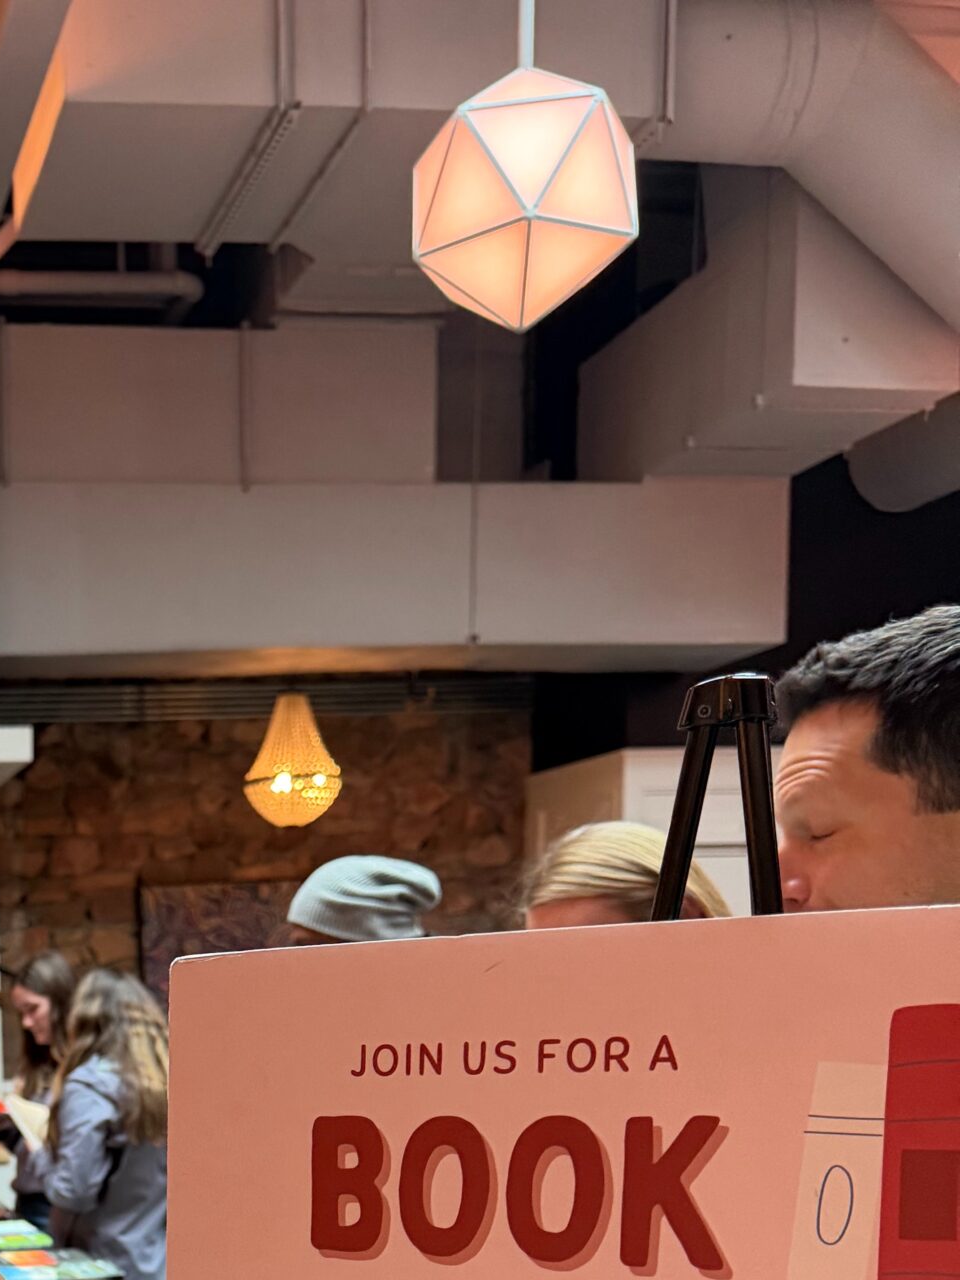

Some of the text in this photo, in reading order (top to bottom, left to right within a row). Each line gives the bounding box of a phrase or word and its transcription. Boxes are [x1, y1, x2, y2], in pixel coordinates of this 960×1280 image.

[350, 1034, 678, 1077] JOIN US FOR A
[311, 1115, 730, 1278] BOOK
